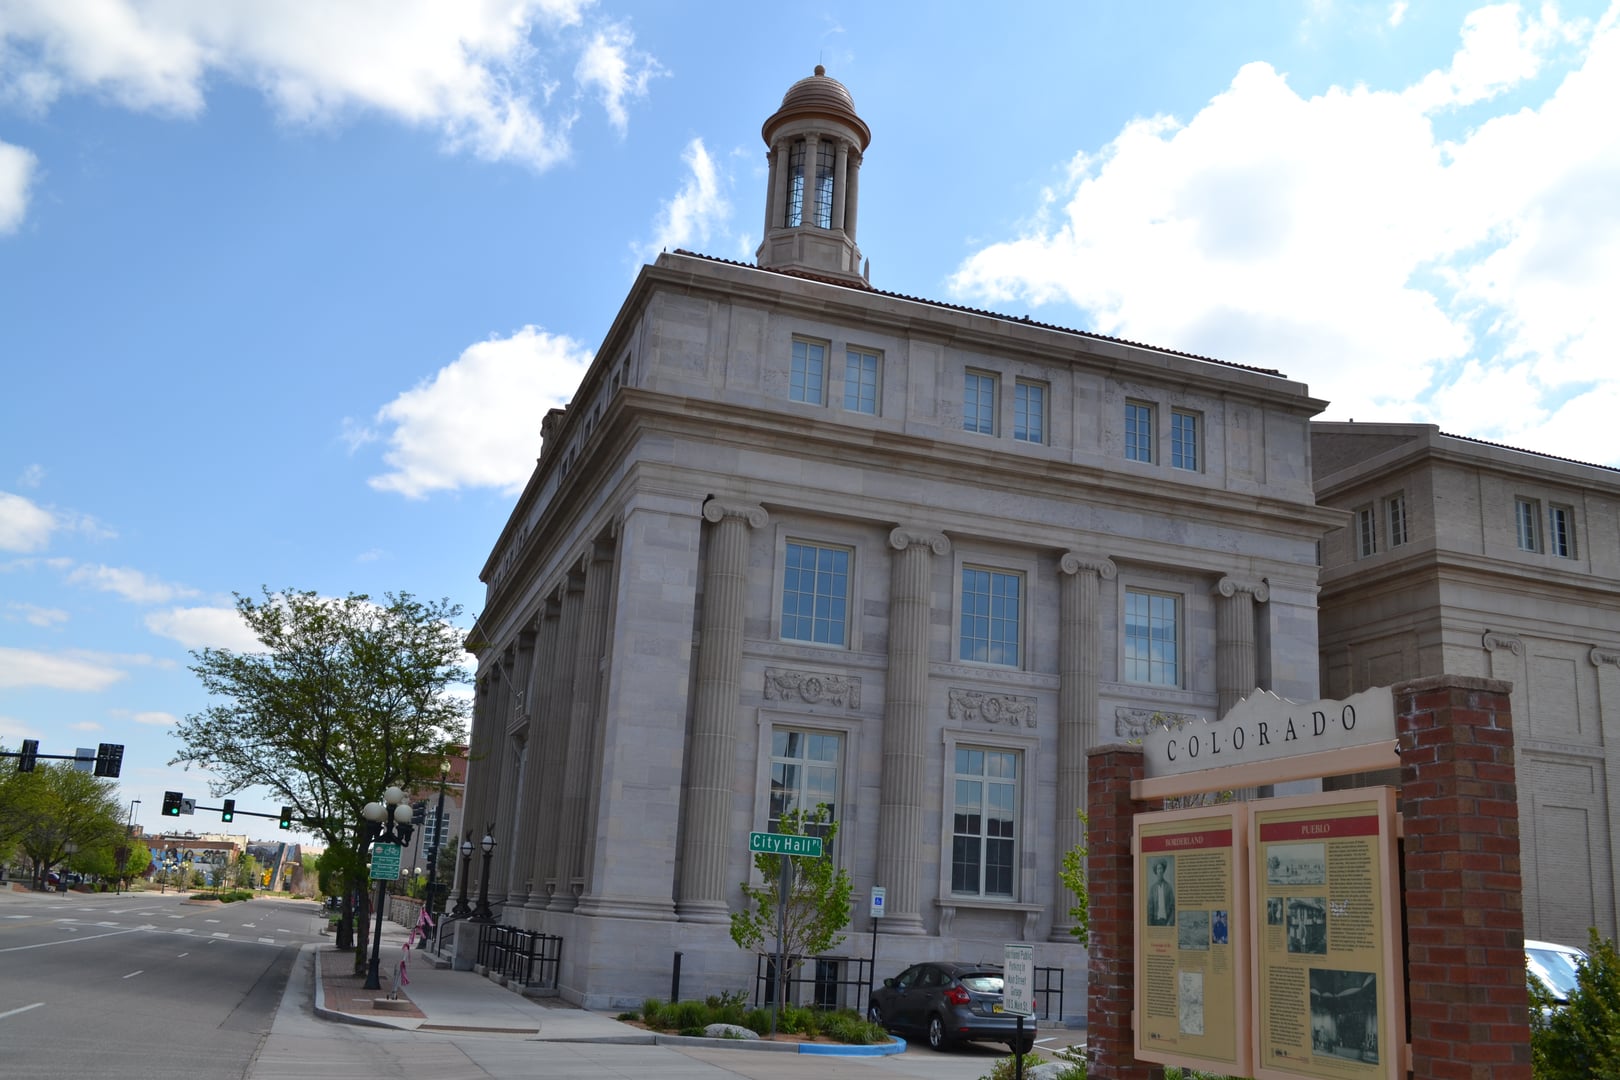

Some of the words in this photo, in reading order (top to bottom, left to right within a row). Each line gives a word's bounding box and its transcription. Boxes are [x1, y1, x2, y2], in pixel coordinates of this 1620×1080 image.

[1301, 824, 1330, 835] PUEBLO
[753, 834, 780, 852] City
[784, 838, 810, 852] Hall
[1165, 835, 1204, 847] BORDERLAND
